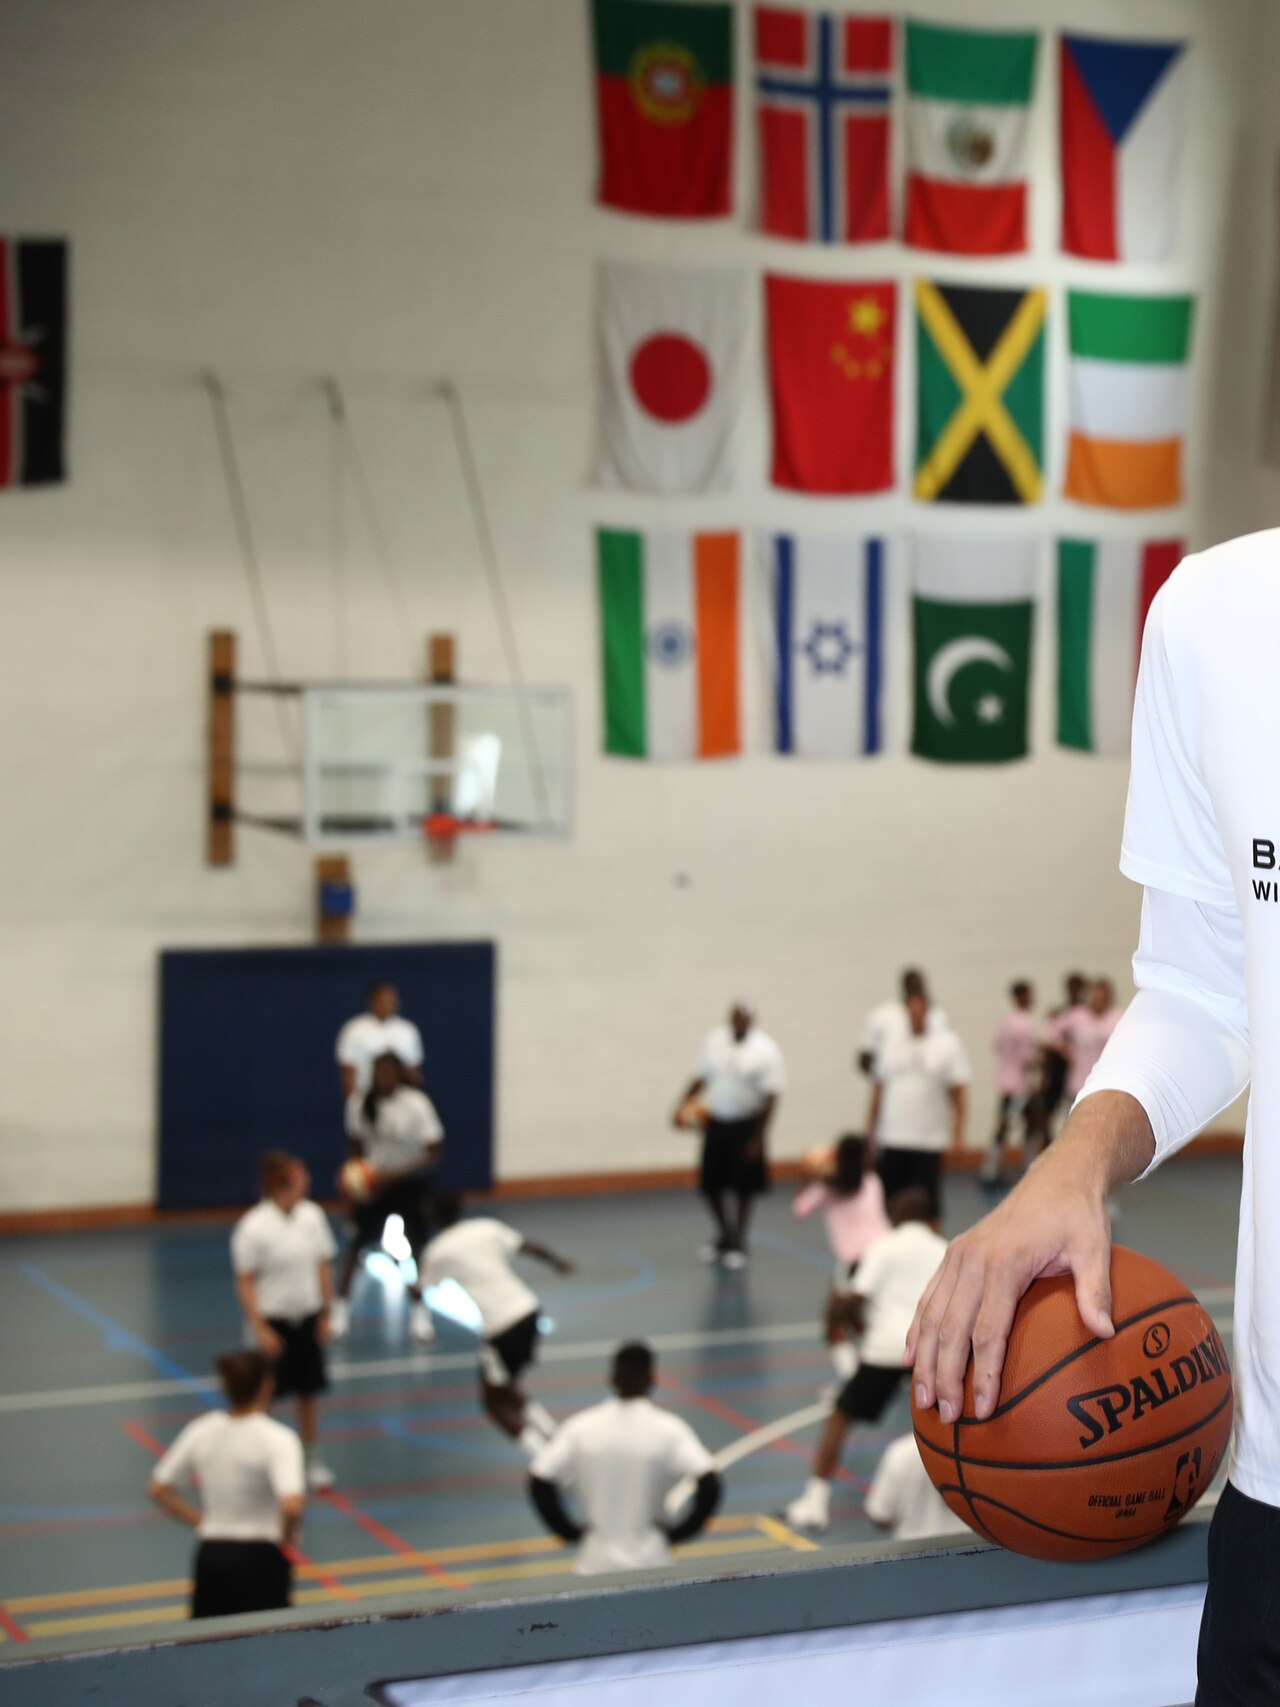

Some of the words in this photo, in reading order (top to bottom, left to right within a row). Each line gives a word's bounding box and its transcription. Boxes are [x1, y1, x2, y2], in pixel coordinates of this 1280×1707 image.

[1088, 1495, 1121, 1507] OFFICIAL
[1125, 1490, 1146, 1506] GAME
[1149, 1487, 1166, 1501] BALL
